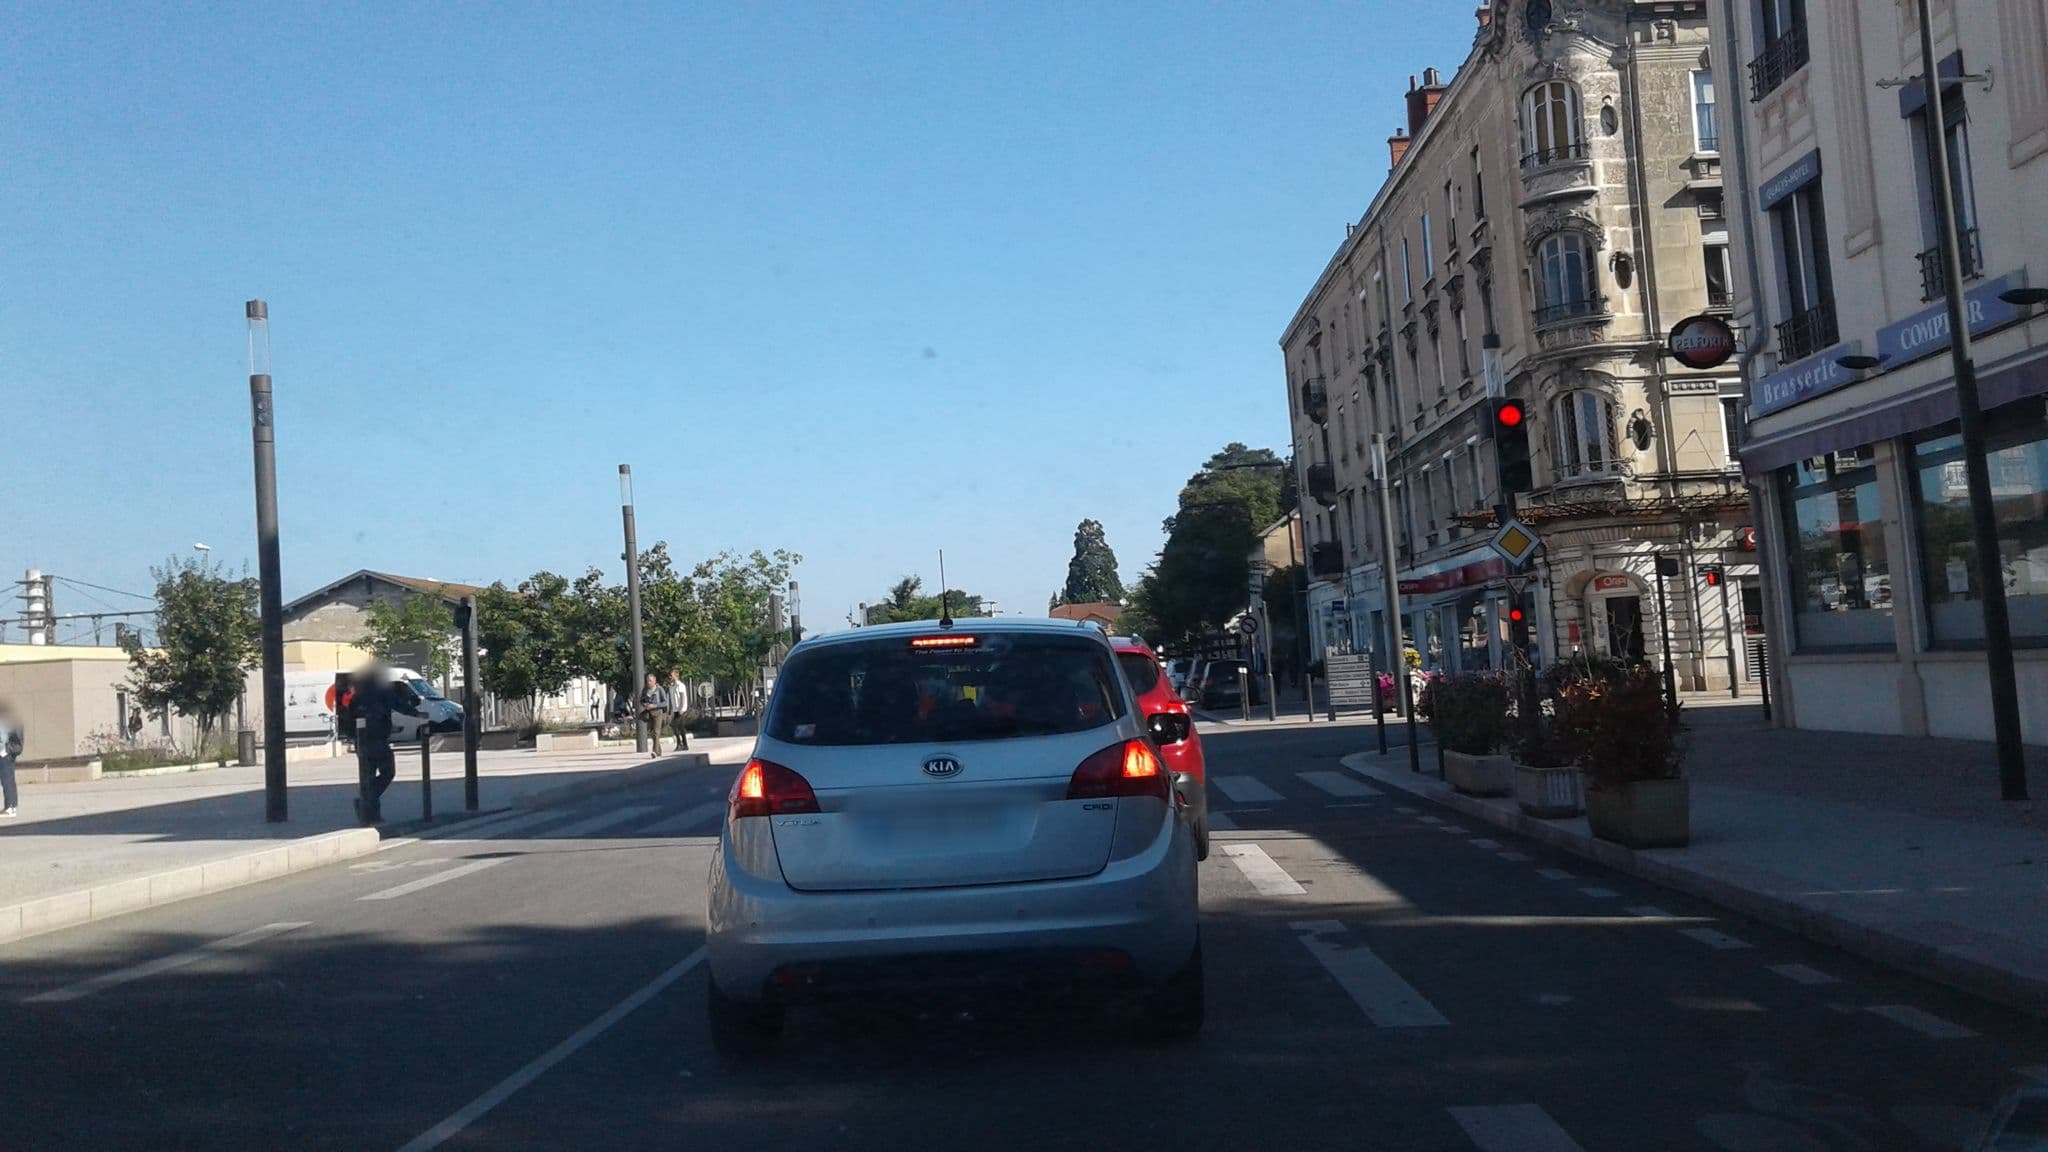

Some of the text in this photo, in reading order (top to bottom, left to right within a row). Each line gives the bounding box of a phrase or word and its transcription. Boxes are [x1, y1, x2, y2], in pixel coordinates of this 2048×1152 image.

[1901, 300, 1984, 350] COMPTR
[1763, 358, 1837, 405] Brasserie
[929, 761, 954, 771] KIA
